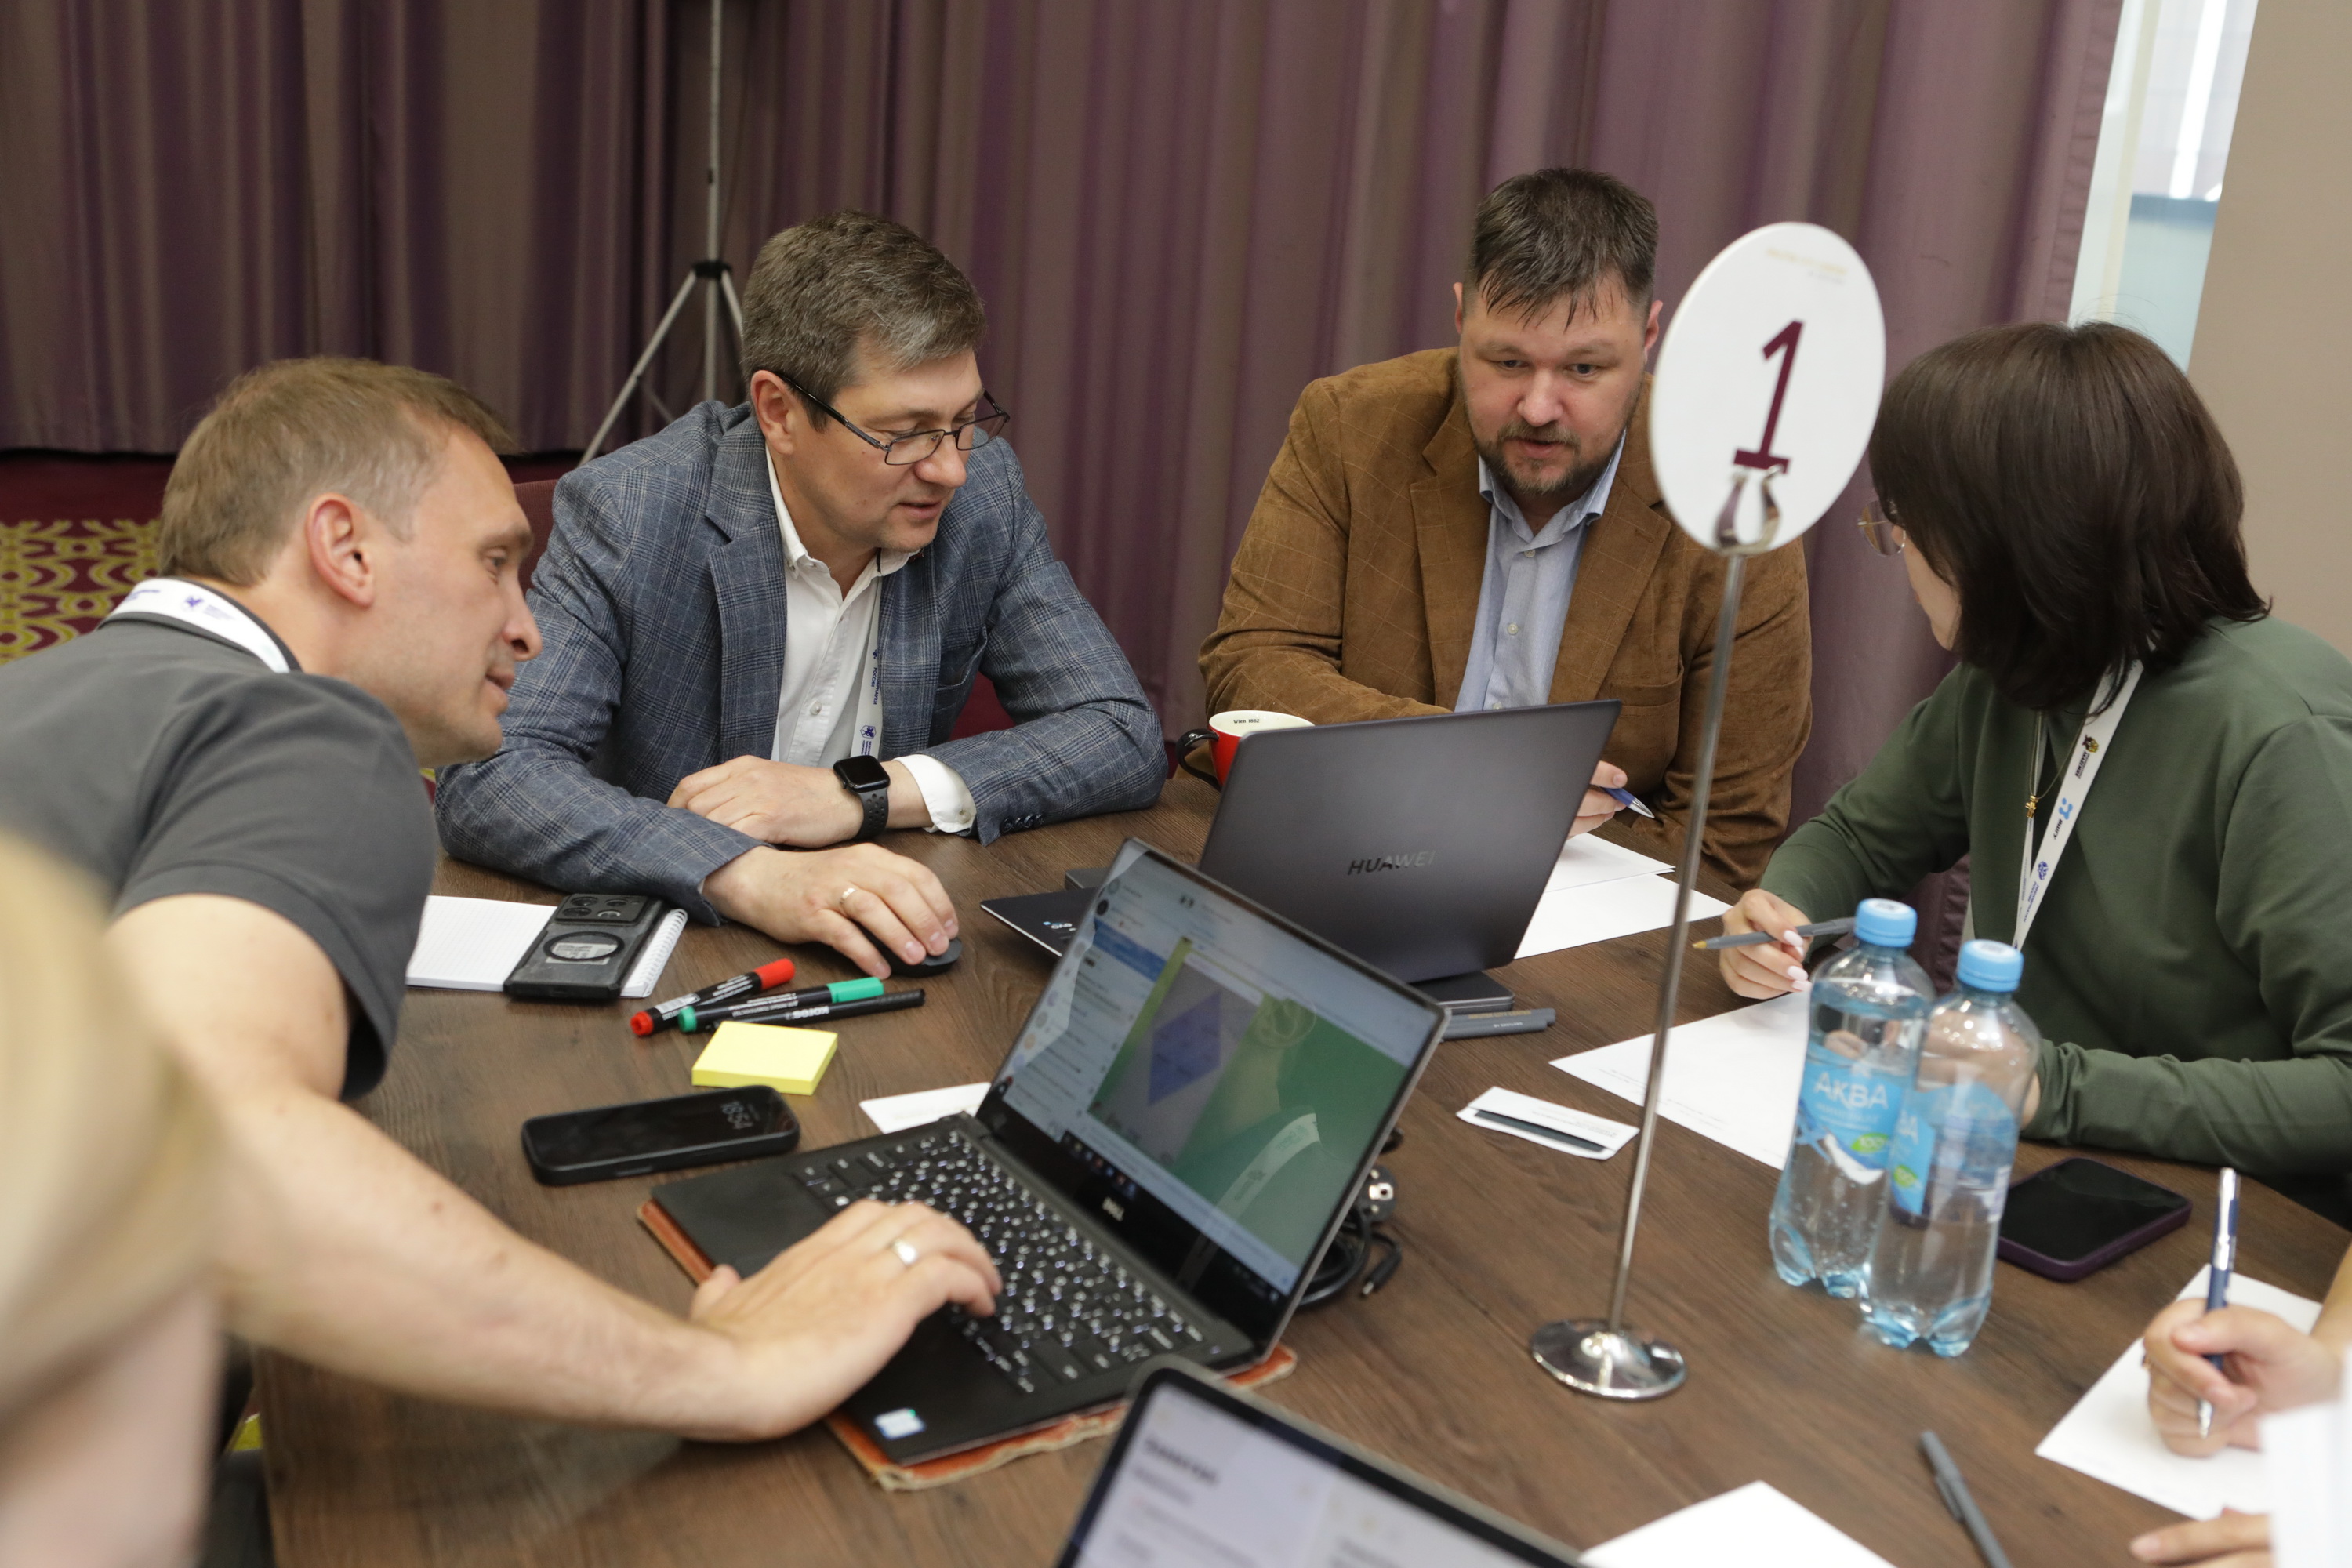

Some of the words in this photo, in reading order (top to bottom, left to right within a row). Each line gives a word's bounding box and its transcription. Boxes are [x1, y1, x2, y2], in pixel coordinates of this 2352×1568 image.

[1733, 320, 1803, 474] 1
[1347, 850, 1437, 876] HUAWEI
[1813, 1071, 1889, 1111] АКВА
